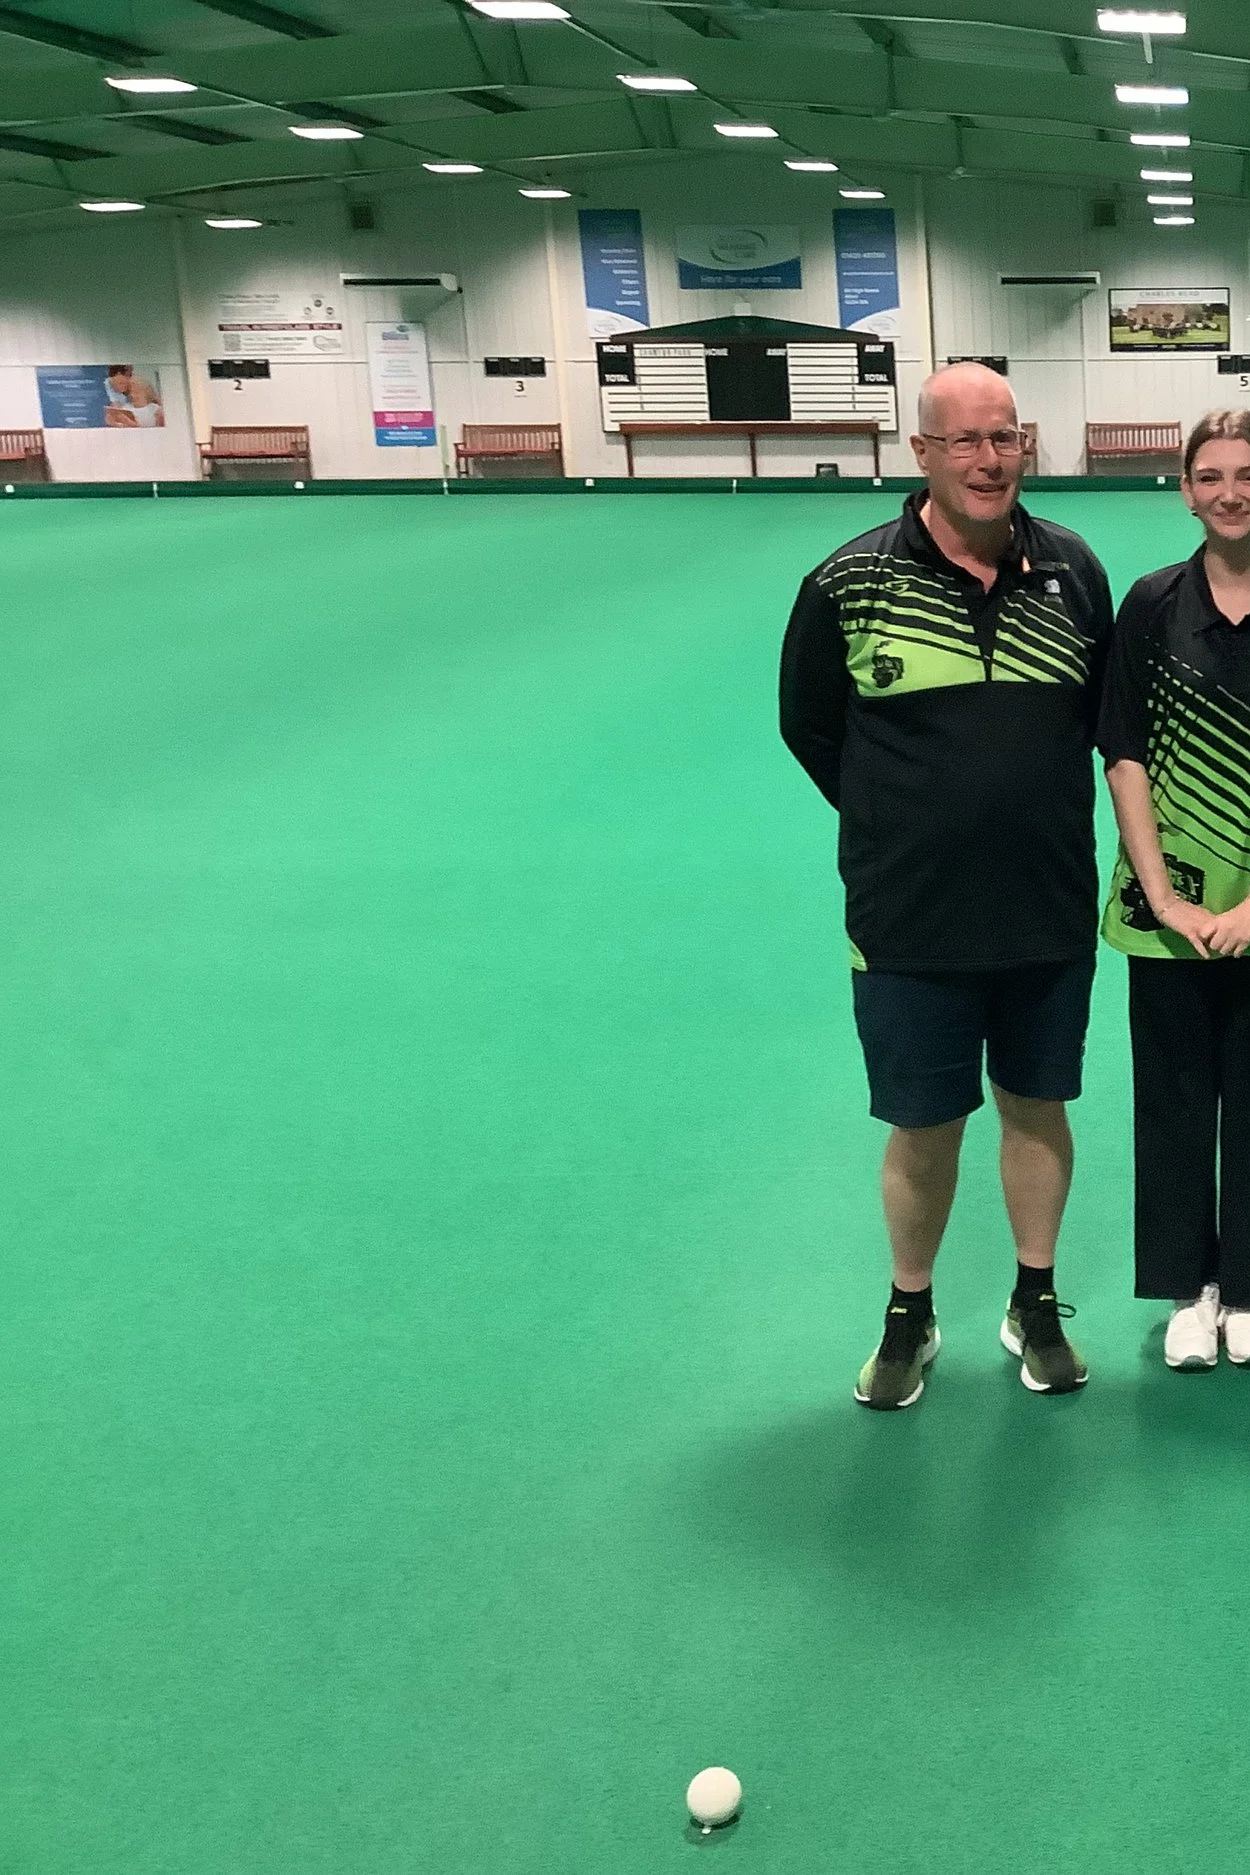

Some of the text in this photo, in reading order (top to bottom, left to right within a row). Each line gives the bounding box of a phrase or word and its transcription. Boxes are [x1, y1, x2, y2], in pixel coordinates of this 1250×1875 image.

[602, 344, 627, 353] HOME
[705, 348, 729, 356] HOME
[864, 344, 886, 353] AWAY
[604, 373, 630, 382] TOTAL
[864, 373, 889, 382] TOTAL
[1240, 375, 1249, 387] 5
[234, 379, 243, 391] 2
[515, 380, 525, 392] 3
